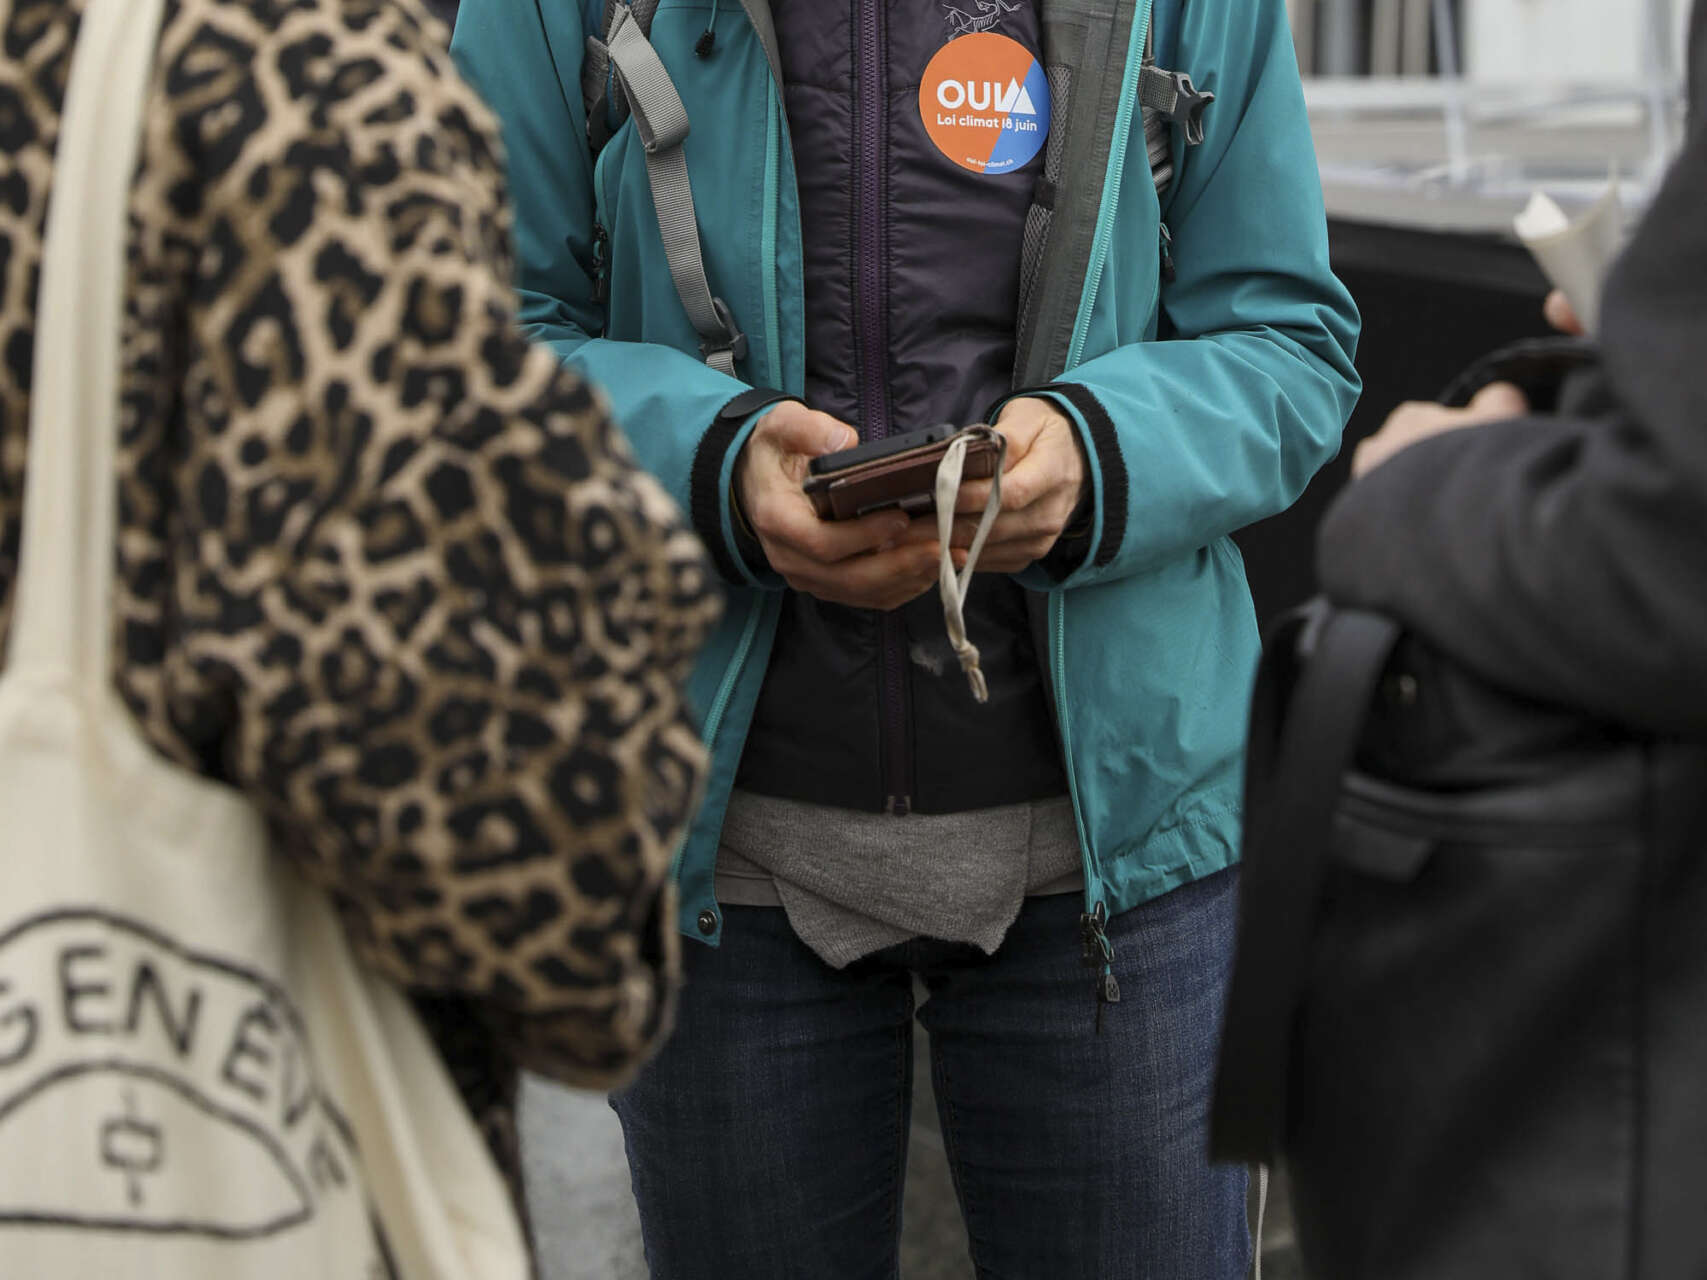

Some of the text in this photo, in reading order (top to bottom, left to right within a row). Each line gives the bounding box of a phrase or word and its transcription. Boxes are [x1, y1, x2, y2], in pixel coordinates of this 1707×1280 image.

[937, 113, 1037, 133] Loi climat 18 juin
